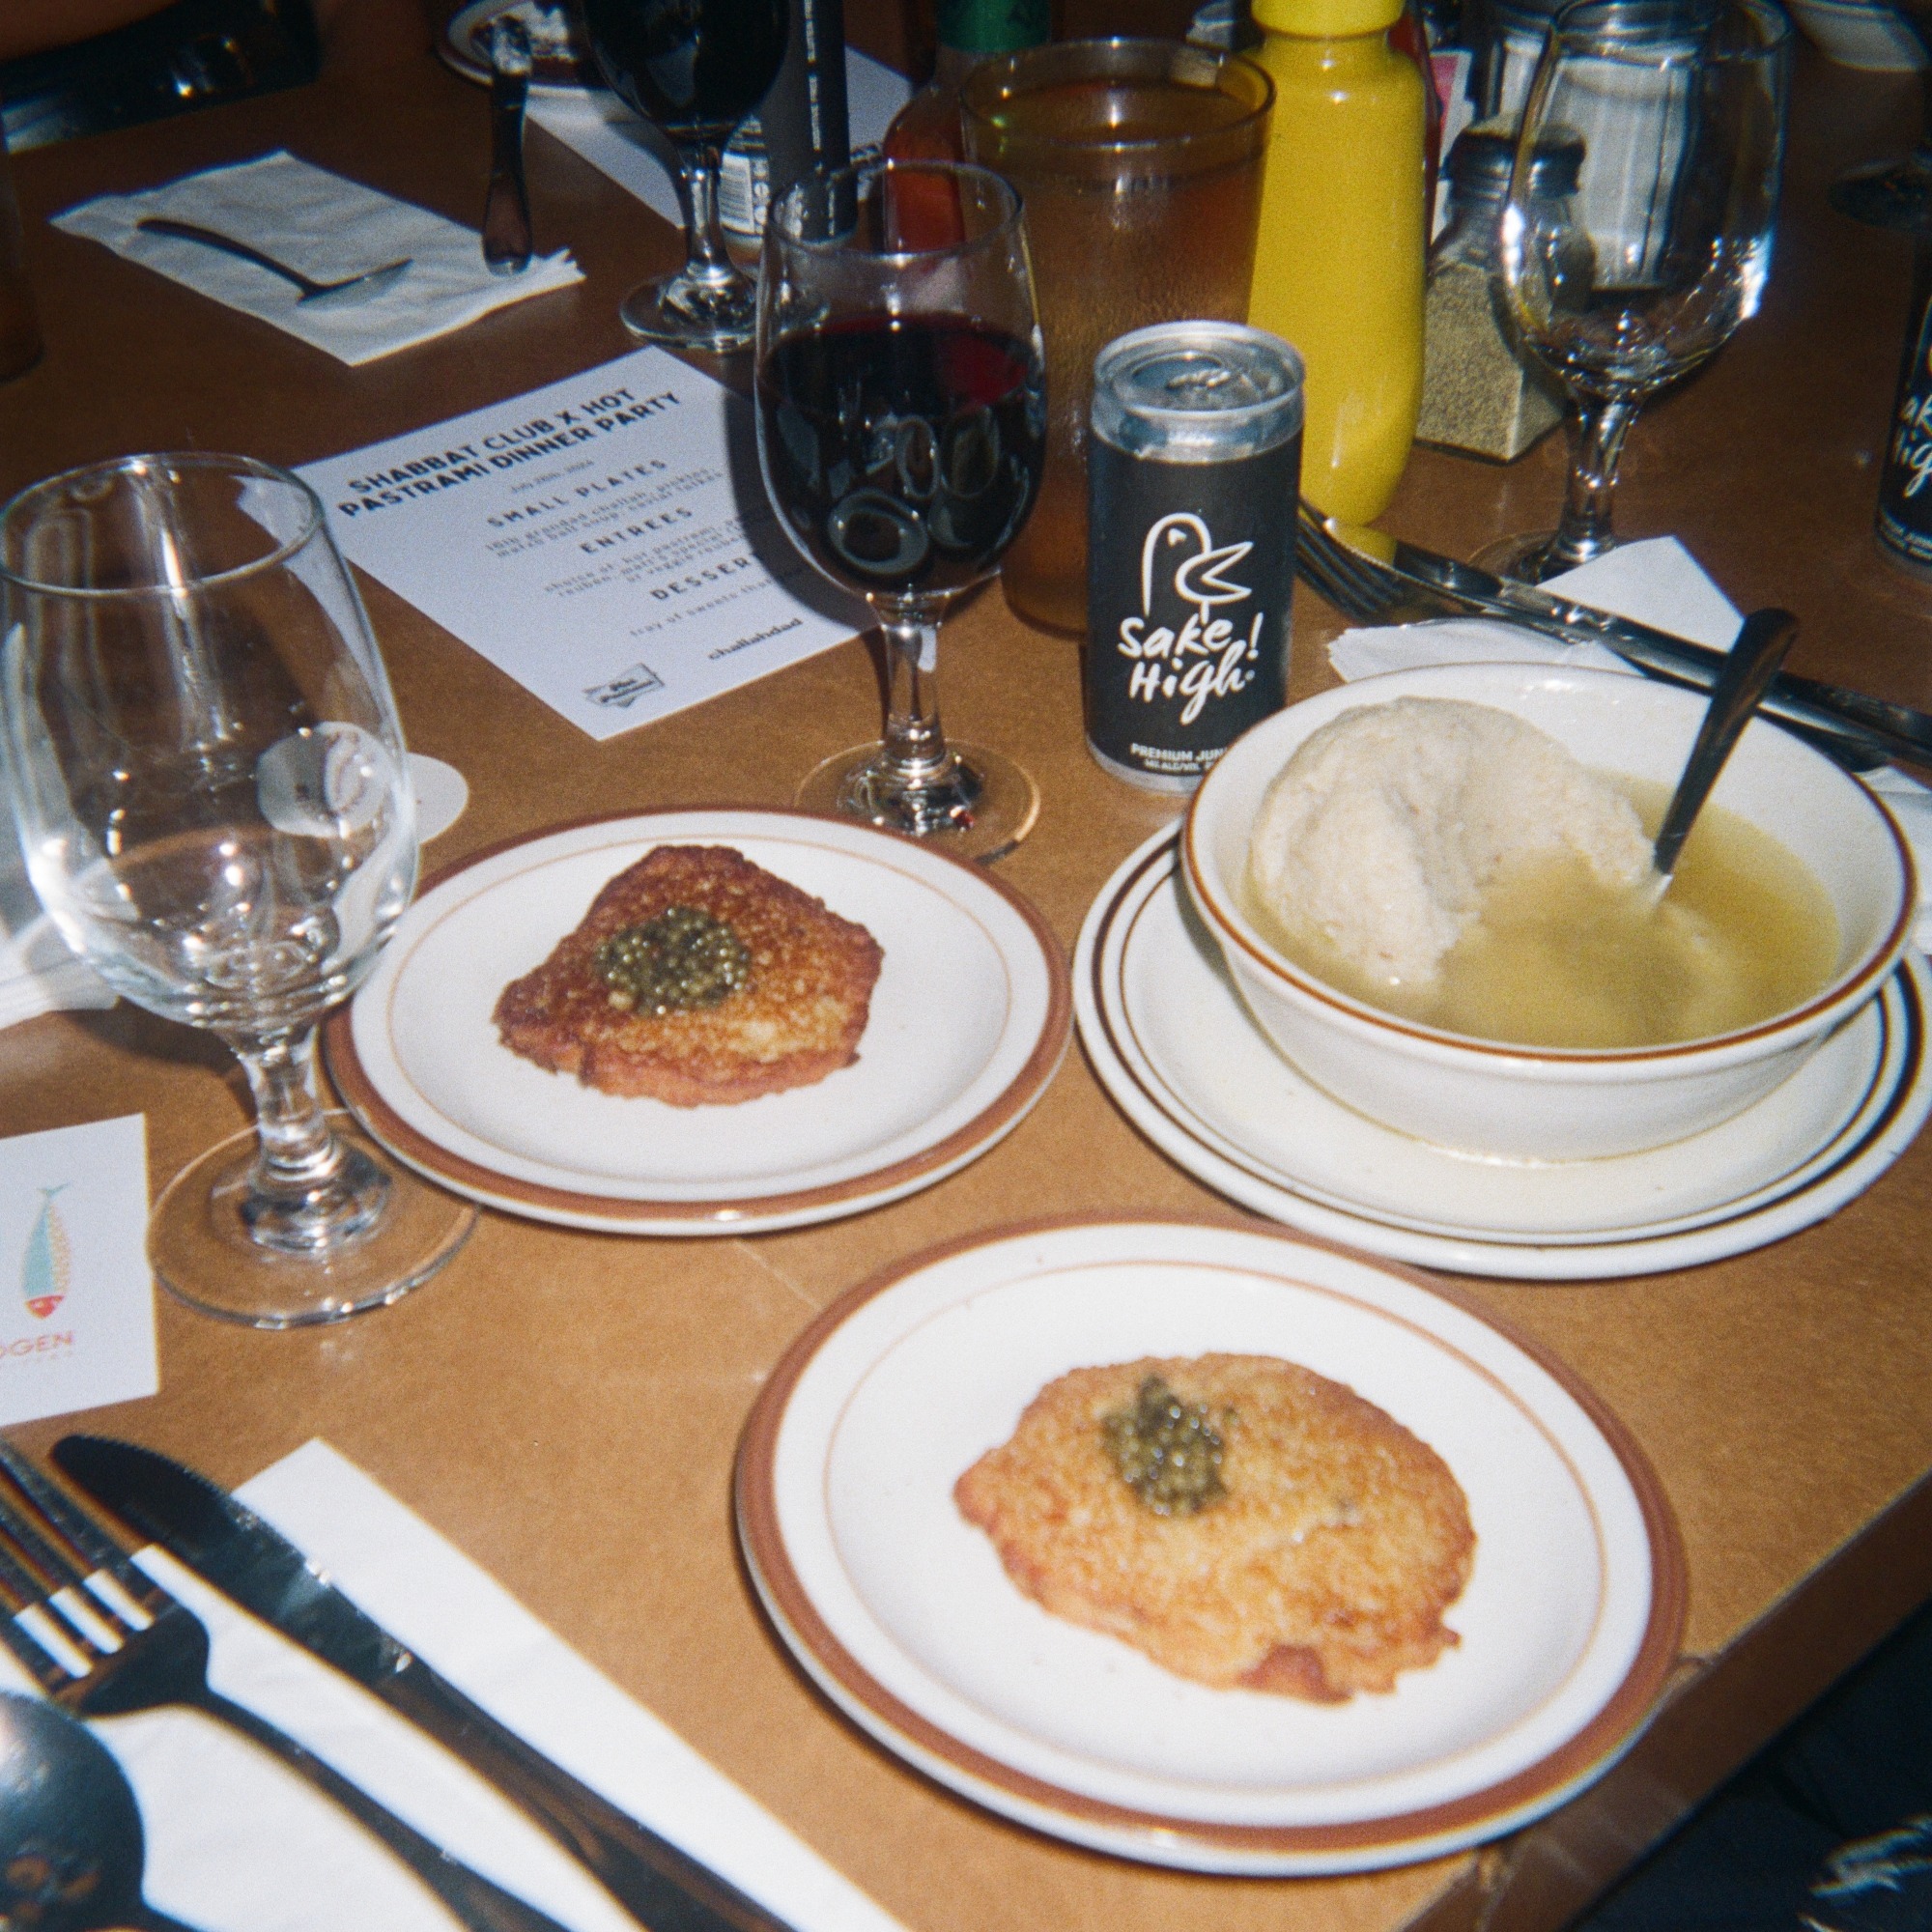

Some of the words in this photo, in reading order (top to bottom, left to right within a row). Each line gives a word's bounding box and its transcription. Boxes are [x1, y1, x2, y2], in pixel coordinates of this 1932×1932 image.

[338, 462, 491, 517] PASTRAMI
[488, 427, 596, 469] DINNER
[593, 391, 680, 432] PARTY
[347, 444, 479, 493] SHABBAT
[483, 419, 555, 450] CLUB
[554, 410, 581, 426] X
[580, 387, 635, 415] HOT
[487, 497, 570, 527] SMALL
[575, 460, 667, 497] PLATES
[579, 507, 693, 554] ENTREES
[707, 616, 804, 660] challahdad
[1117, 611, 1264, 661] Sake!
[1130, 742, 1194, 761] PREMIUM
[0, 1329, 74, 1359] GEN
